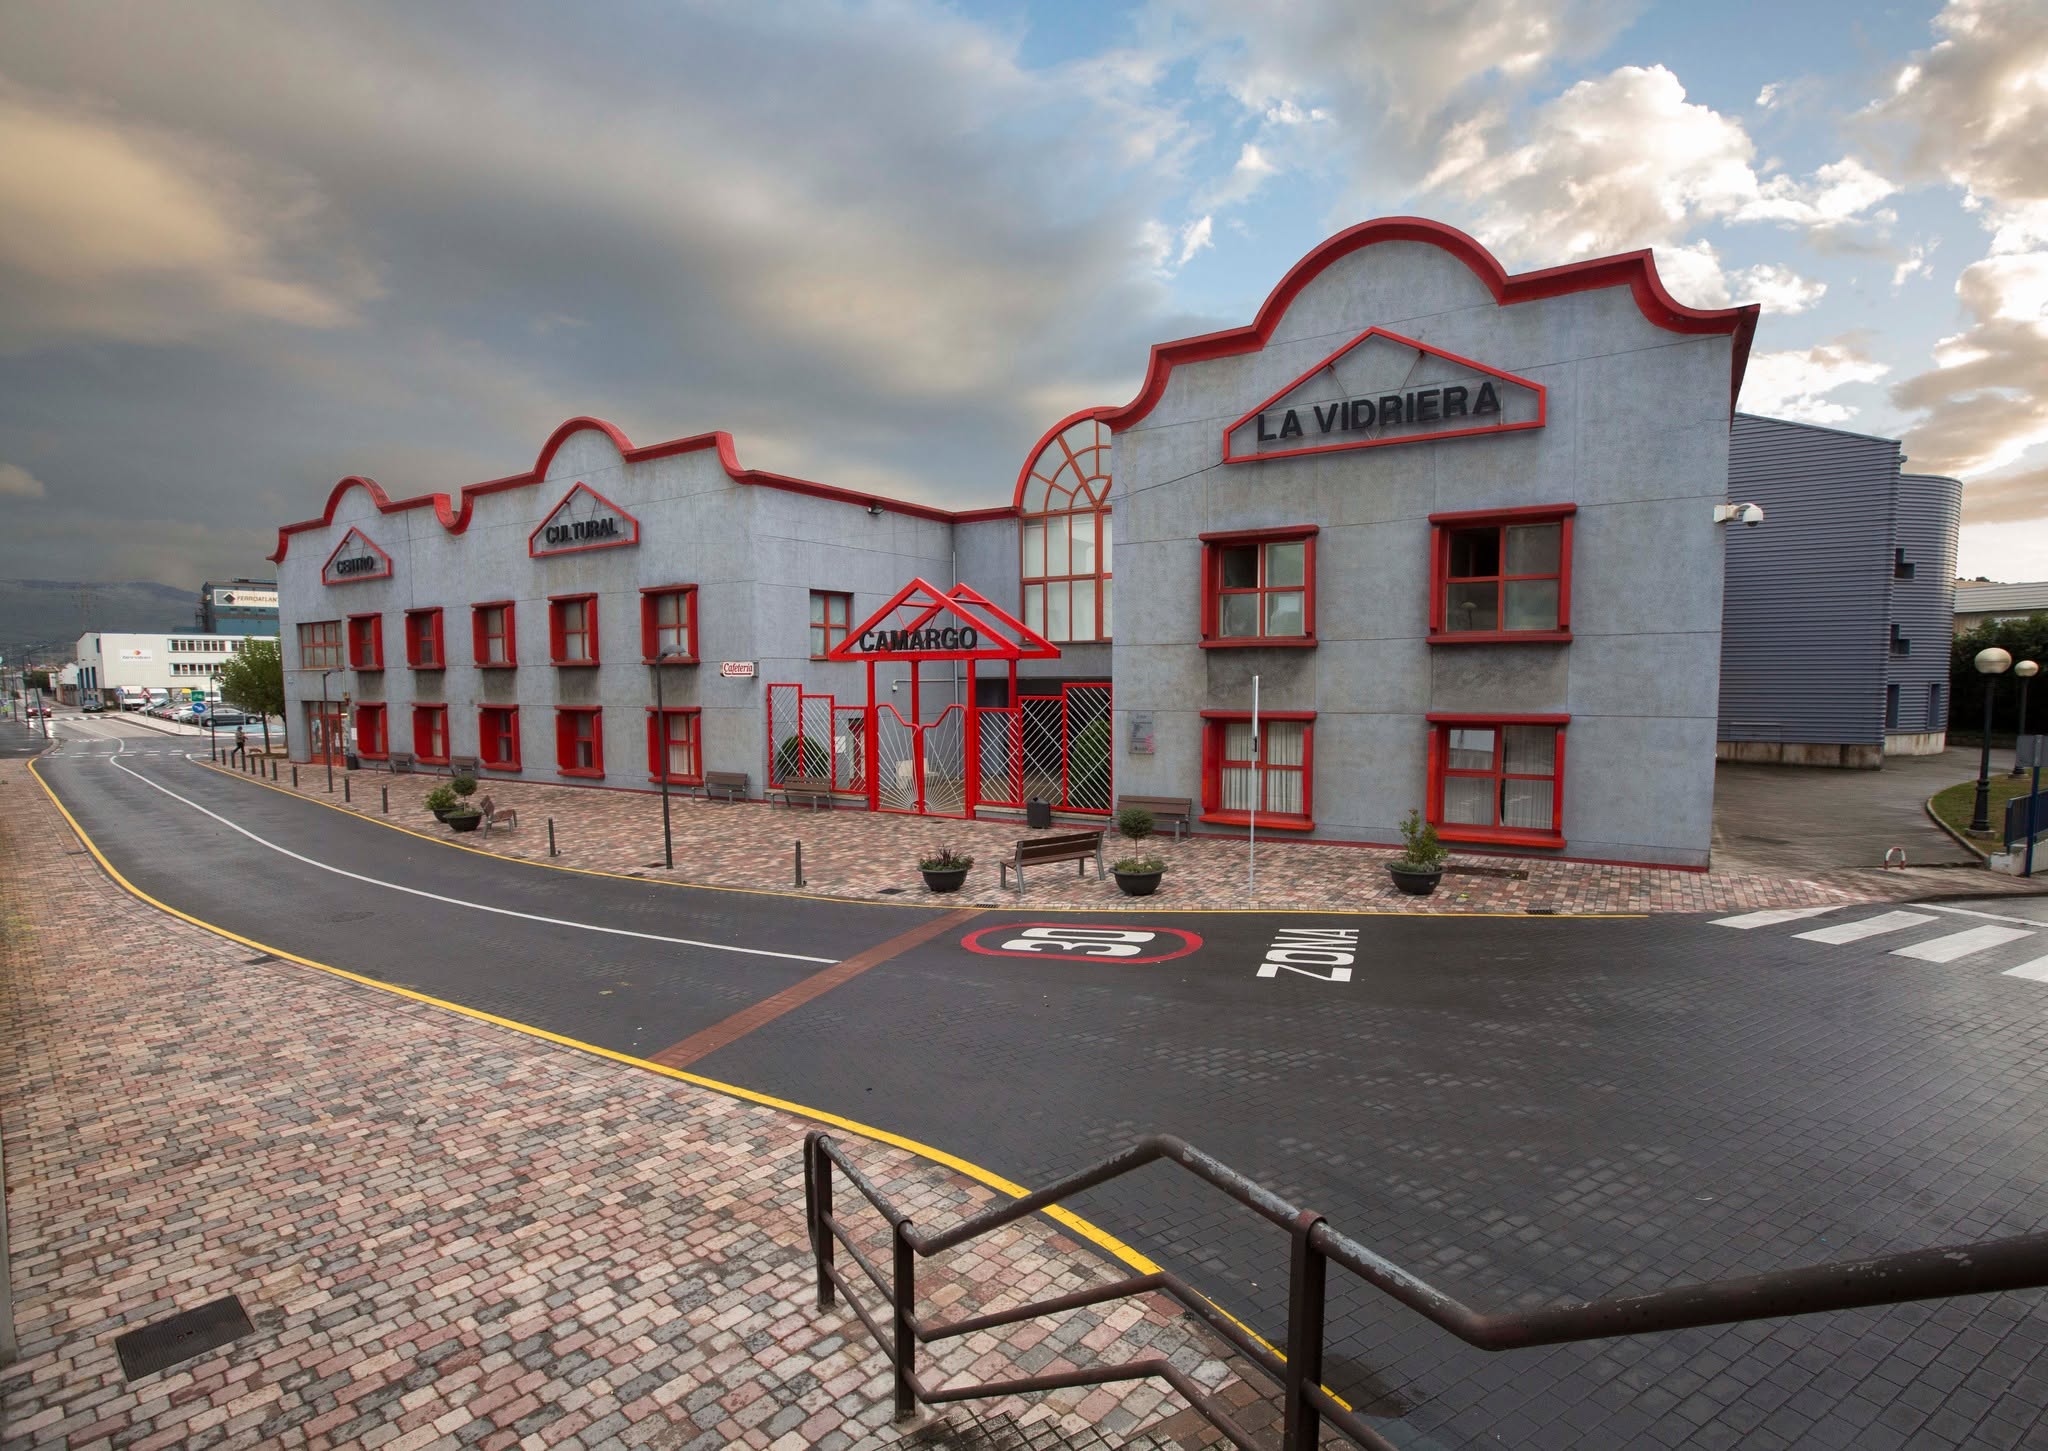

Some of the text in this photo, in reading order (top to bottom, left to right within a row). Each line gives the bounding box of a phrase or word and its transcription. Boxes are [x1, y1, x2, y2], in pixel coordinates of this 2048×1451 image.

[1258, 381, 1502, 441] LA VIDRIERA
[546, 518, 618, 544] CULTURAL
[336, 556, 374, 574] CENTRO
[859, 626, 978, 652] CAMARGO
[1001, 927, 1156, 958] 30
[1256, 928, 1360, 982] ZONA
